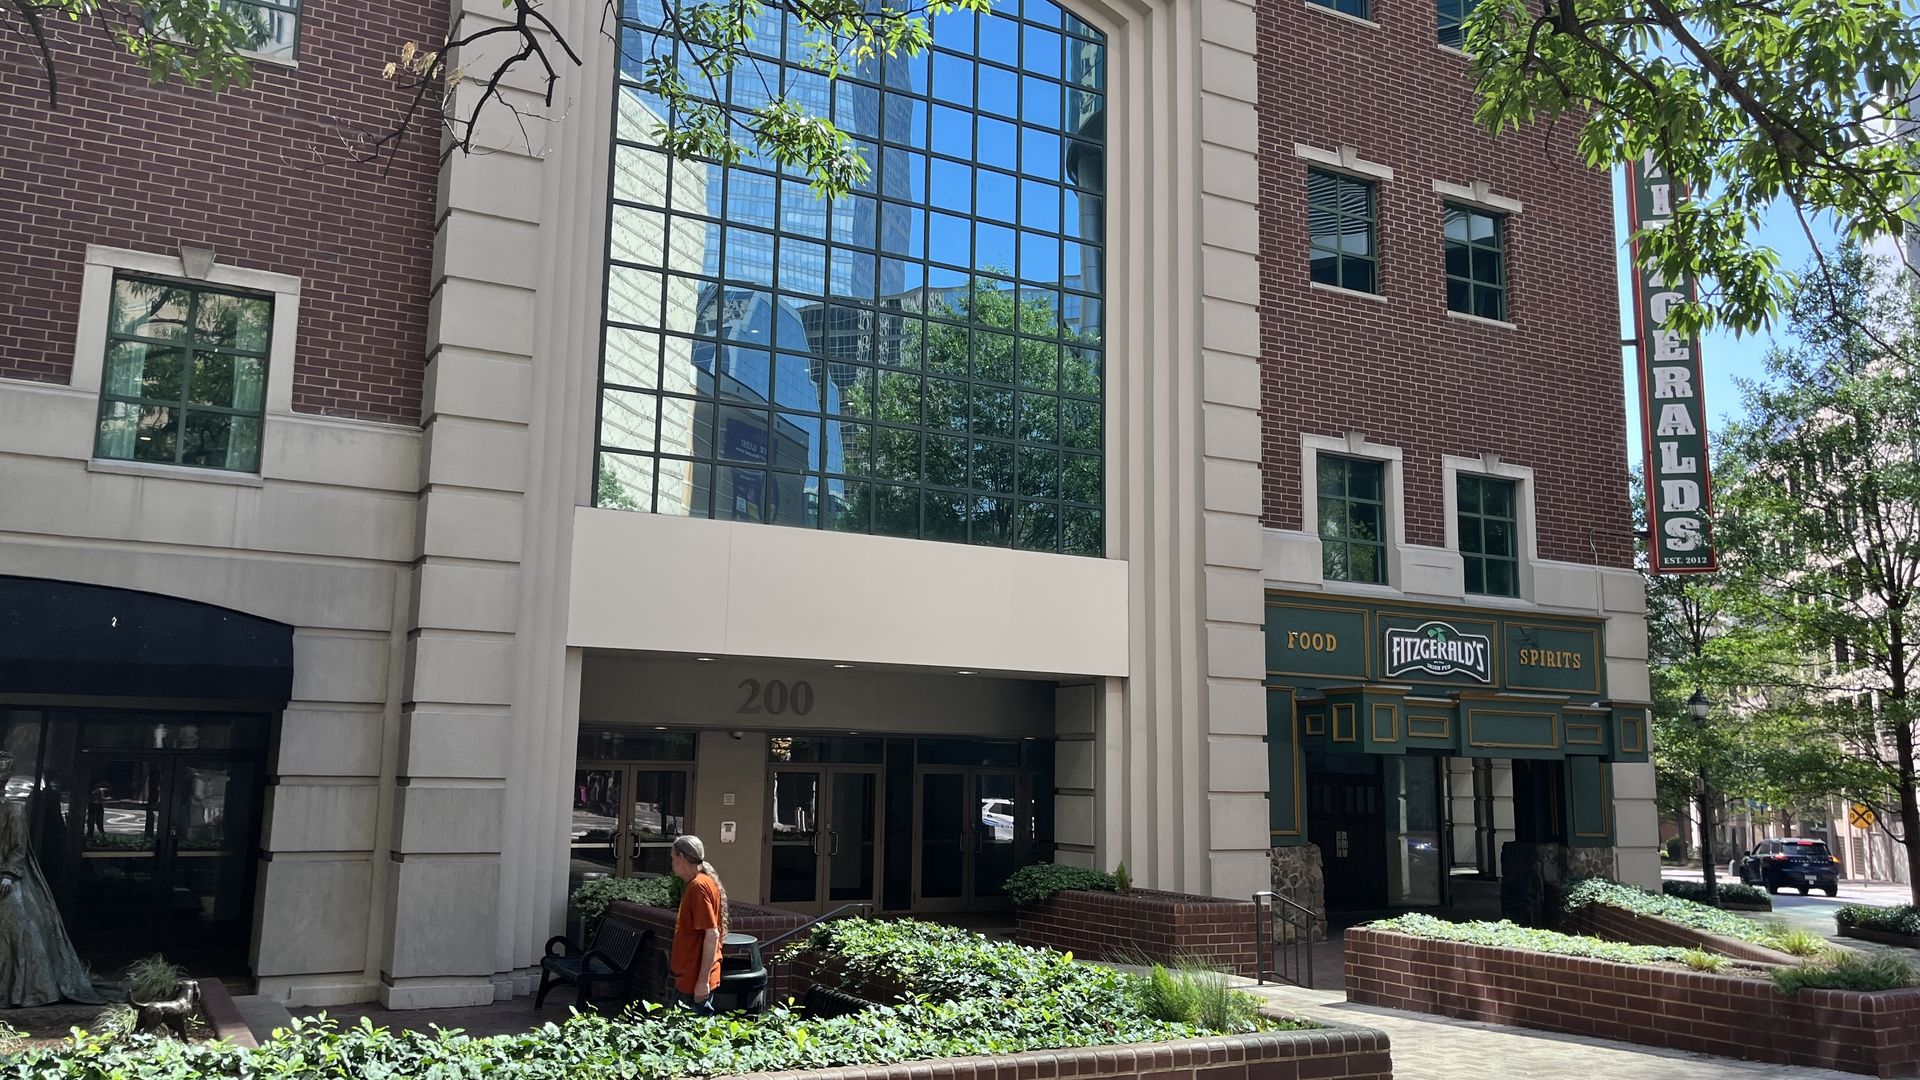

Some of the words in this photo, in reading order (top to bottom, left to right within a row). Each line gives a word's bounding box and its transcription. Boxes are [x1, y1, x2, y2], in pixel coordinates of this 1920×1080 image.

[1287, 630, 1337, 652] FOOD
[1392, 637, 1484, 673] FITZGERALD'S
[1519, 648, 1582, 670] SPIRITS
[736, 678, 814, 716] 200
